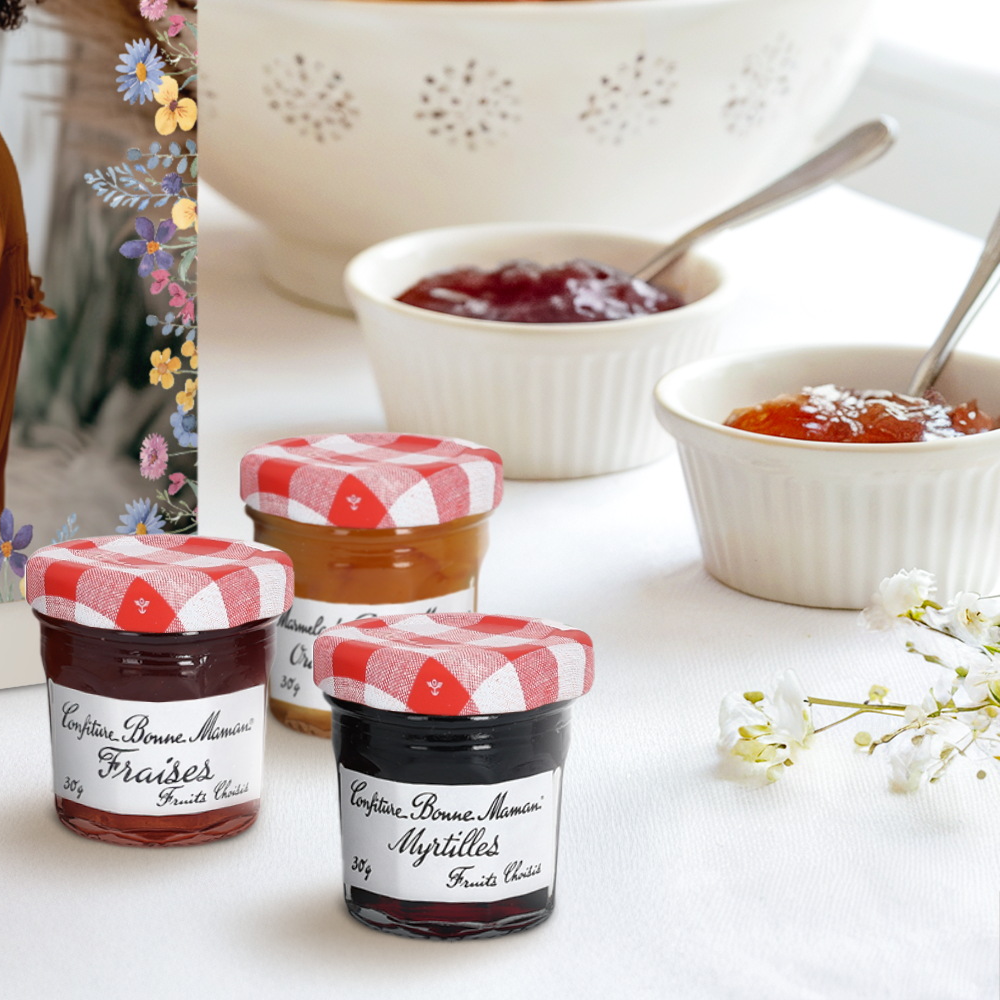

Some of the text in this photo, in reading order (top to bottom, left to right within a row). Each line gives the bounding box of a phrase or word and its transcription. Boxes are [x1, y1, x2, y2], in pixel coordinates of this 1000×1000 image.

[61, 700, 120, 741] Confiture
[122, 713, 187, 745] Bonne
[98, 746, 216, 785] Fraises
[156, 784, 208, 807] Fruits
[213, 779, 250, 801] Choisis
[350, 779, 409, 818] Confiture
[410, 791, 476, 822] Bonne
[387, 826, 500, 868] Myrtilles
[446, 865, 498, 888] Fruits
[503, 859, 542, 884] Choisis
